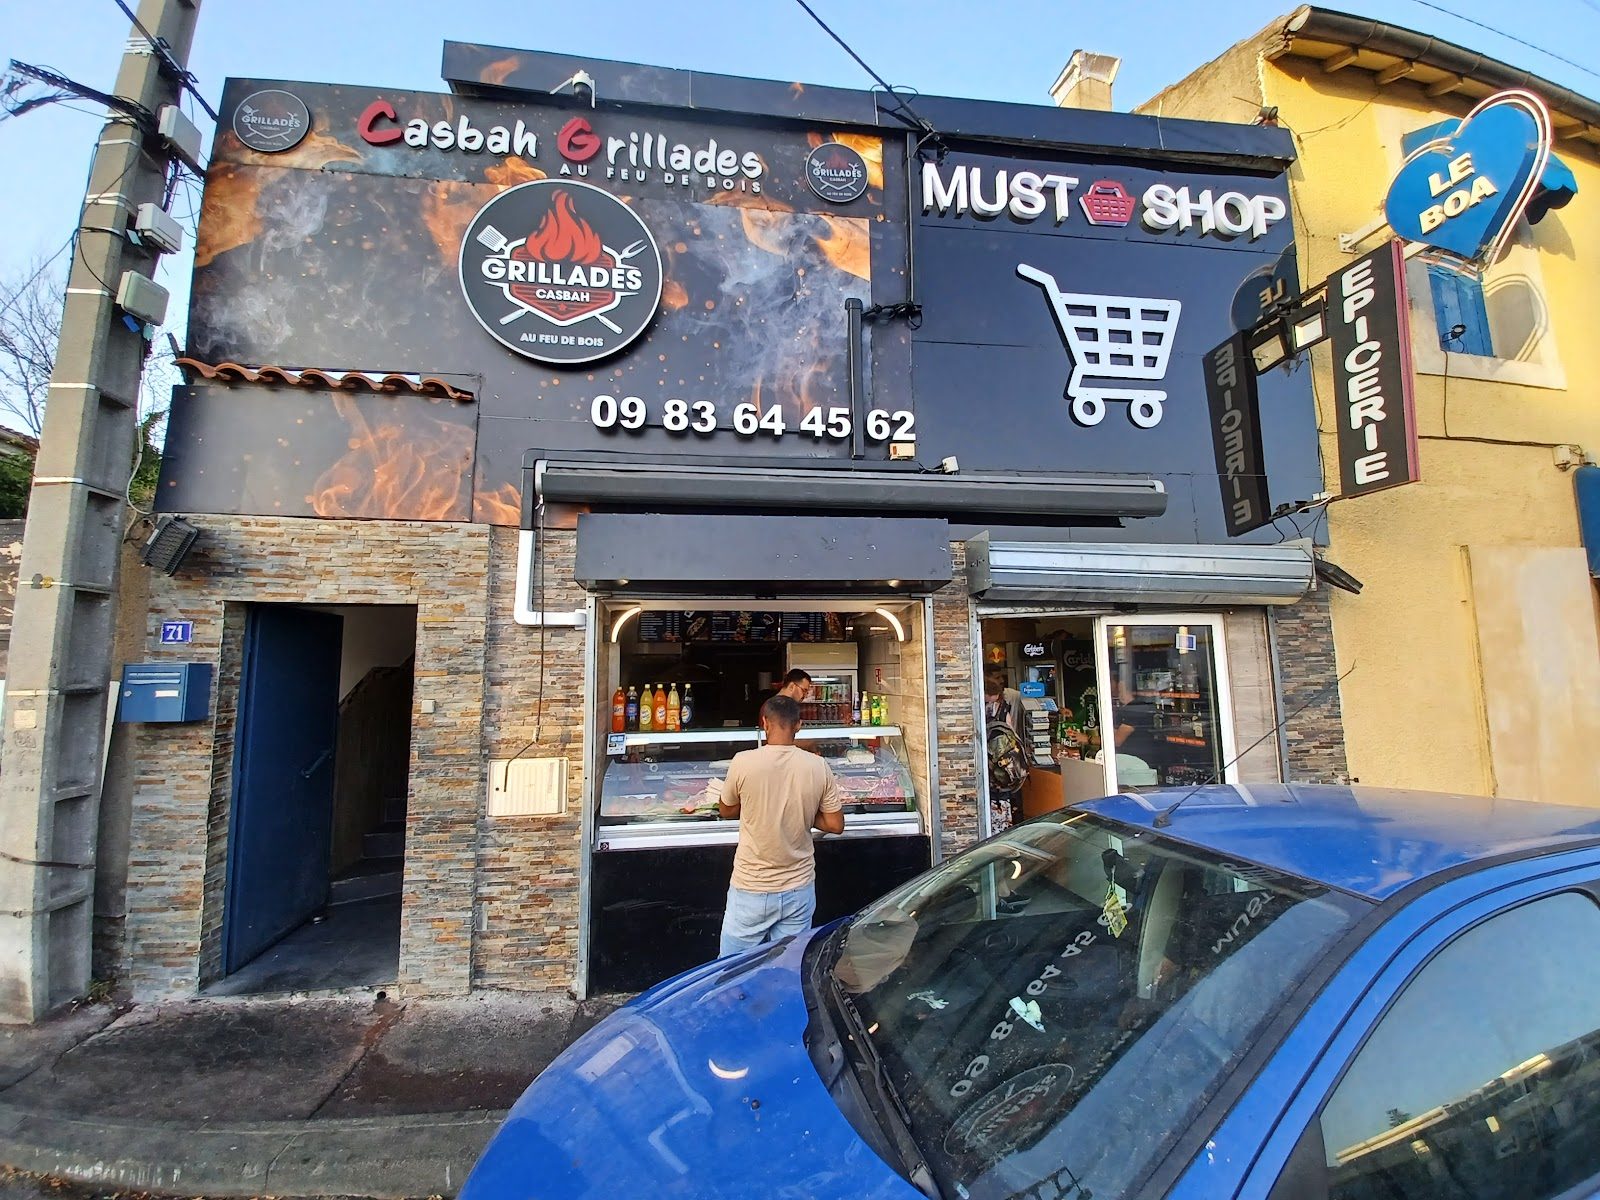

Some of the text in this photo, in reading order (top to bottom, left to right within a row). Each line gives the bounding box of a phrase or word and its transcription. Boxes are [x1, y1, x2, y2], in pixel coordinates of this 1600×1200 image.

[241, 114, 301, 128] GRILLADES
[357, 100, 764, 179] Casbah Grillades
[559, 163, 762, 194] AU FEU DE BOIS
[812, 167, 862, 178] GRILLADES
[1428, 152, 1476, 198] LE
[921, 162, 1287, 239] MUST SHOP
[1418, 175, 1499, 236] BOA
[481, 258, 643, 291] GRILLADES
[535, 288, 591, 303] CASBAH
[519, 332, 605, 348] AU FEU DE BOIS
[1341, 258, 1390, 486] EPICERIE
[590, 394, 917, 441] 09 83 64 45 62
[166, 625, 183, 640] 71
